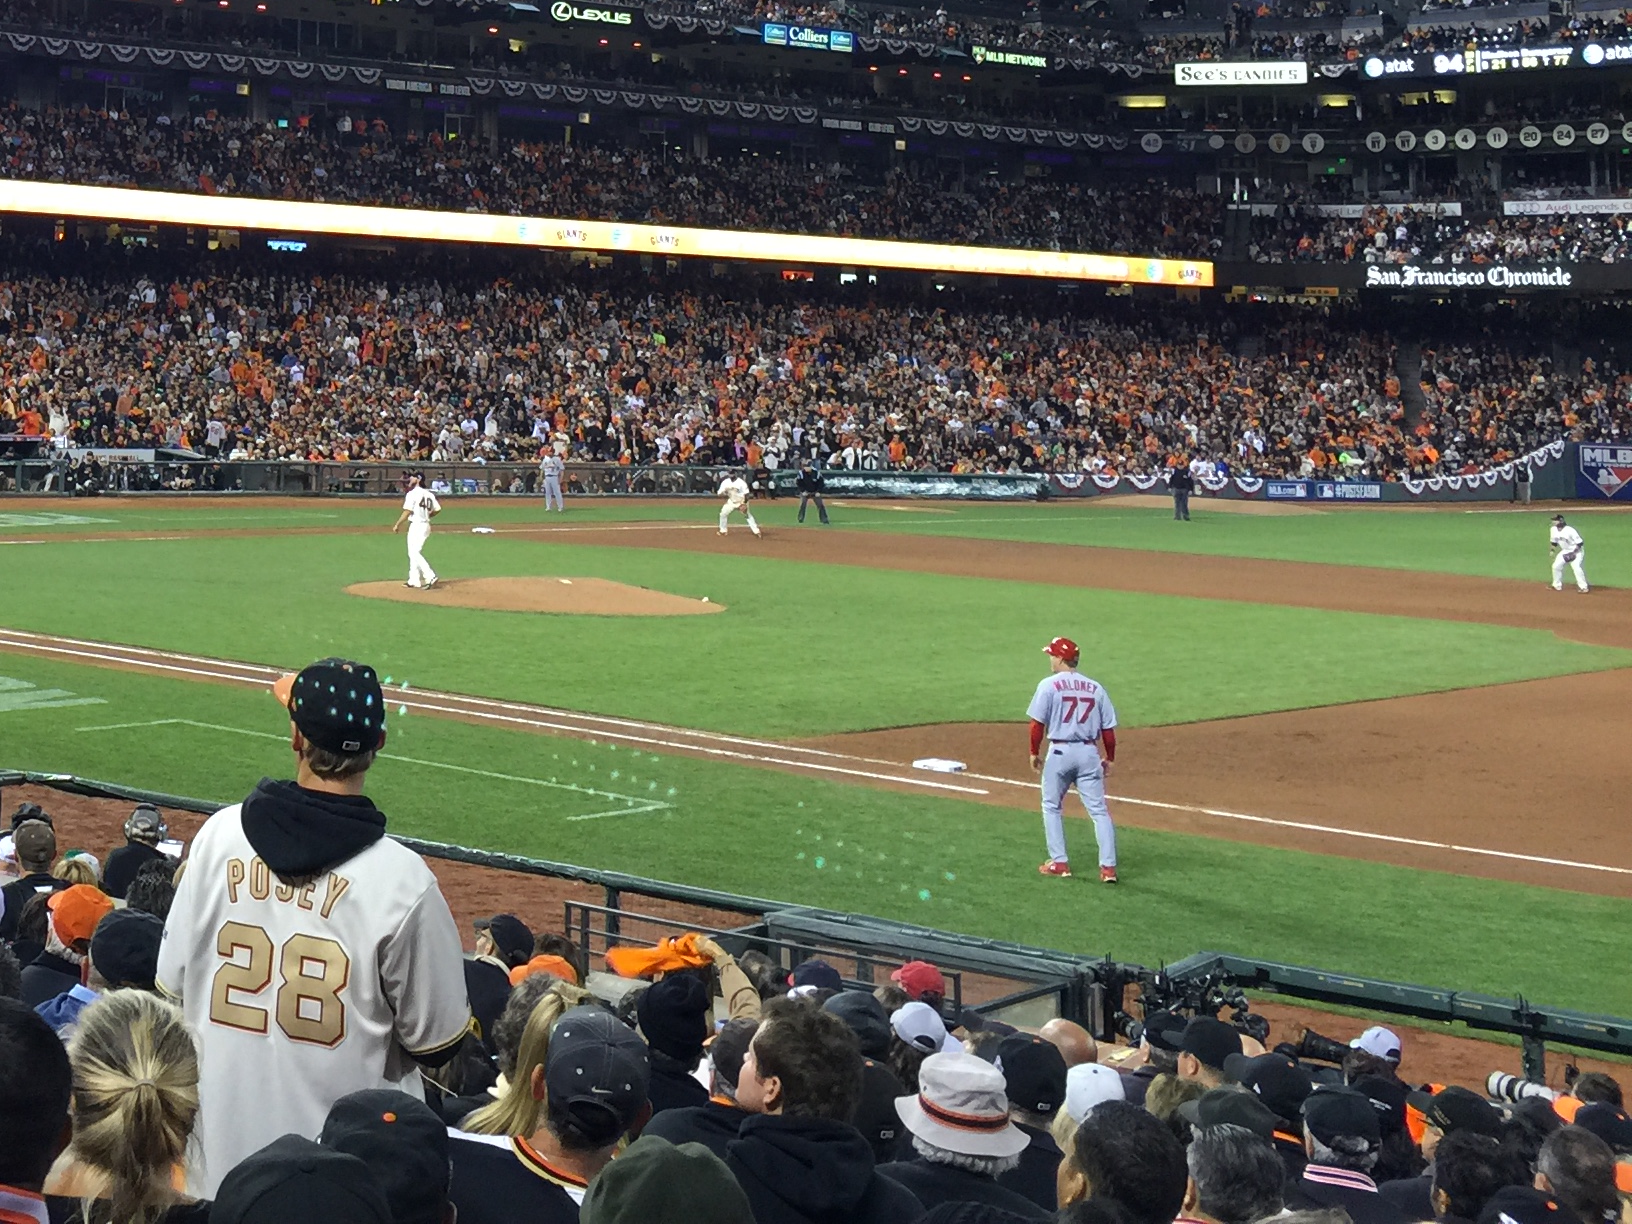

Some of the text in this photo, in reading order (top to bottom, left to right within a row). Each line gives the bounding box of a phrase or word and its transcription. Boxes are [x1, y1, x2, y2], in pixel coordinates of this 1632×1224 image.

[573, 7, 631, 25] LEXUS
[789, 26, 828, 43] Colliers
[985, 51, 1047, 68] MLB NETWORK
[1434, 53, 1465, 74] 94
[1491, 58, 1507, 70] 21
[1554, 55, 1570, 66] 77
[1181, 66, 1228, 81] See's
[1431, 135, 1439, 145] 3
[1461, 134, 1469, 144] 4
[1492, 133, 1502, 143] 11
[1524, 131, 1538, 142] 20
[1557, 130, 1572, 140] 24
[1590, 128, 1605, 139] 27
[1545, 203, 1571, 212] Audi
[1575, 201, 1619, 214] Legends
[556, 229, 588, 242] GIANTS
[650, 235, 680, 247] GIANTS
[1366, 265, 1572, 288] San Francisco Chronicle
[1583, 448, 1632, 463] MLB
[1335, 484, 1380, 498] #POSTSEASON
[419, 496, 434, 511] 40
[1053, 679, 1099, 694] MALONEY
[1061, 696, 1096, 724] 77
[227, 855, 350, 919] POSEY
[209, 920, 350, 1048] 28
